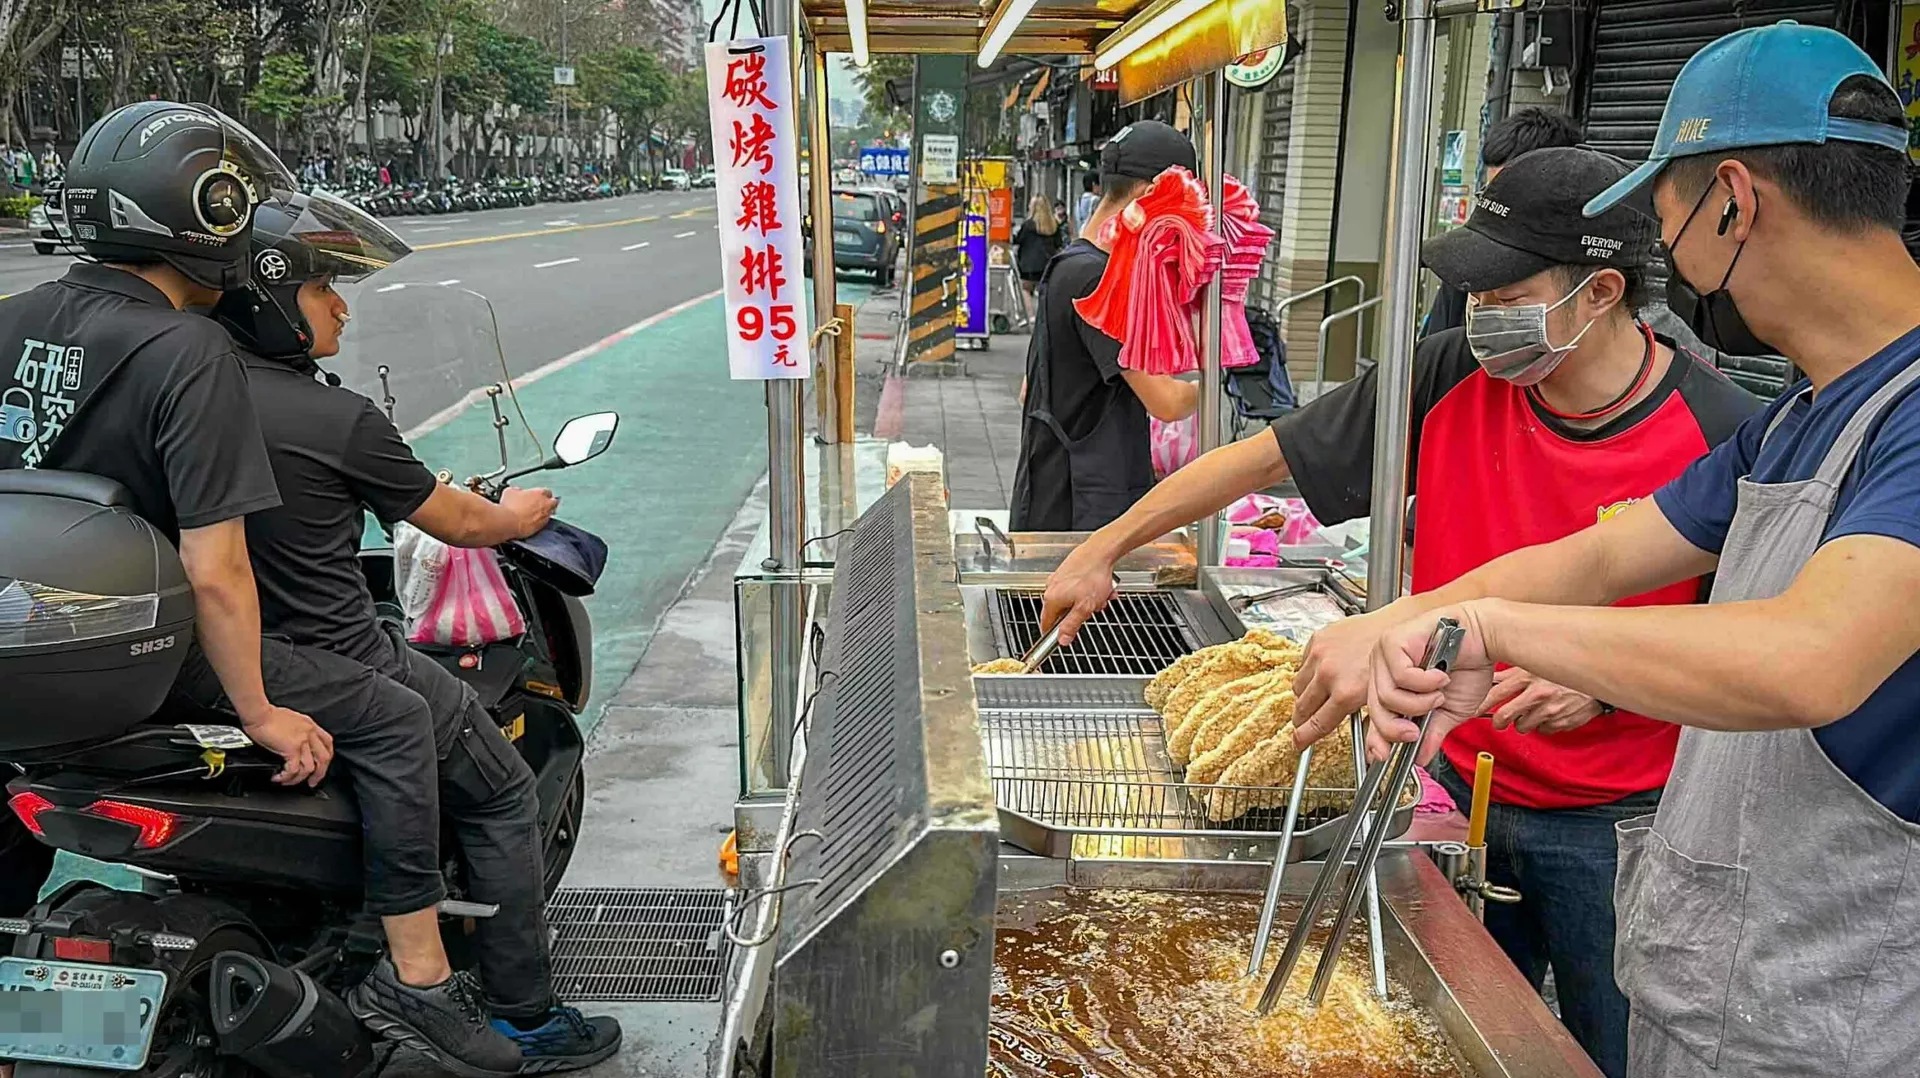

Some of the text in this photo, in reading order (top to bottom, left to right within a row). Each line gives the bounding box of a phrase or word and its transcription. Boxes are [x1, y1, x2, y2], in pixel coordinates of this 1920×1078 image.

[140, 114, 219, 147] ASTONE
[1675, 118, 1712, 143] NIKE
[722, 53, 786, 300] 碳烤雞排
[1489, 201, 1510, 217] SIDE
[180, 230, 228, 243] ASTONE
[1581, 235, 1623, 251] EVERYDAY
[1586, 247, 1613, 259] #STEP
[737, 305, 796, 341] 95
[772, 344, 797, 367] 元
[66, 351, 80, 386] 士林
[130, 635, 175, 656] SH33
